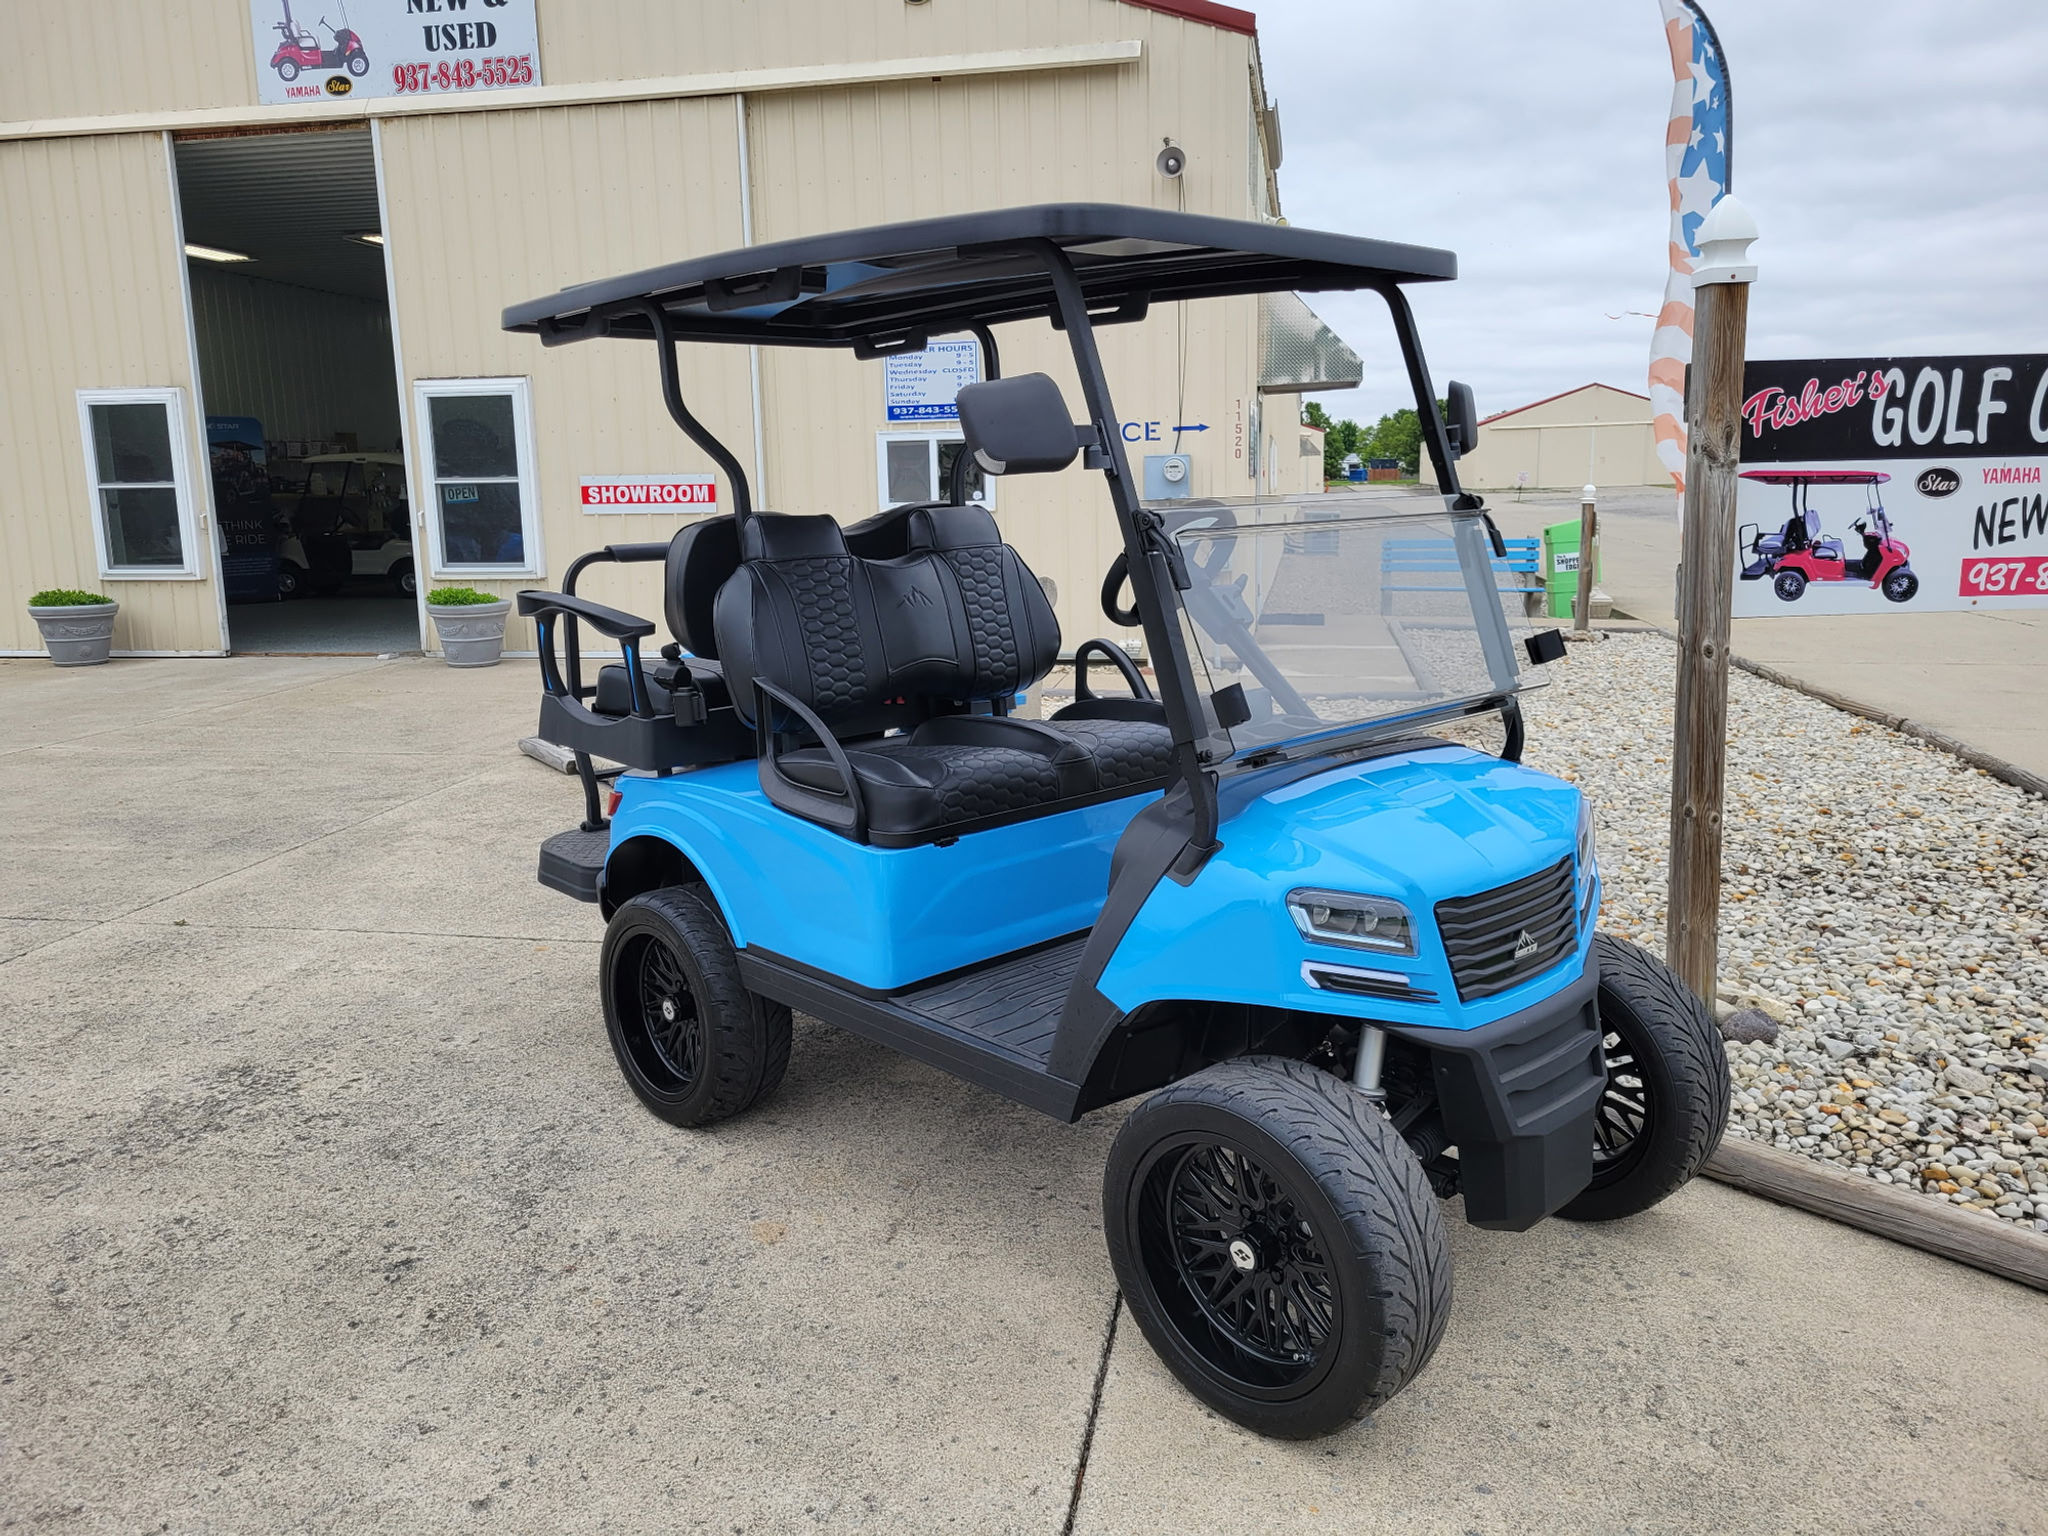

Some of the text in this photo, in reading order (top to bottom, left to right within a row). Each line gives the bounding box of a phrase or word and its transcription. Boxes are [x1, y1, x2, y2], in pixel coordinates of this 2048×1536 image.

[422, 21, 497, 52] USED
[393, 54, 534, 95] 937-843-5525
[284, 85, 321, 98] YAMAHA
[326, 78, 351, 94] Star
[938, 345, 973, 353] HOURS
[1741, 369, 1891, 439] Fisher's
[1872, 365, 2013, 447] GOLF
[1918, 473, 1958, 492] Star
[1983, 467, 2041, 484] YAMAHA
[447, 486, 475, 500] OPEN
[588, 485, 709, 504] SHOWROOM
[1973, 493, 2048, 551] NEW
[235, 533, 265, 545] RIDE
